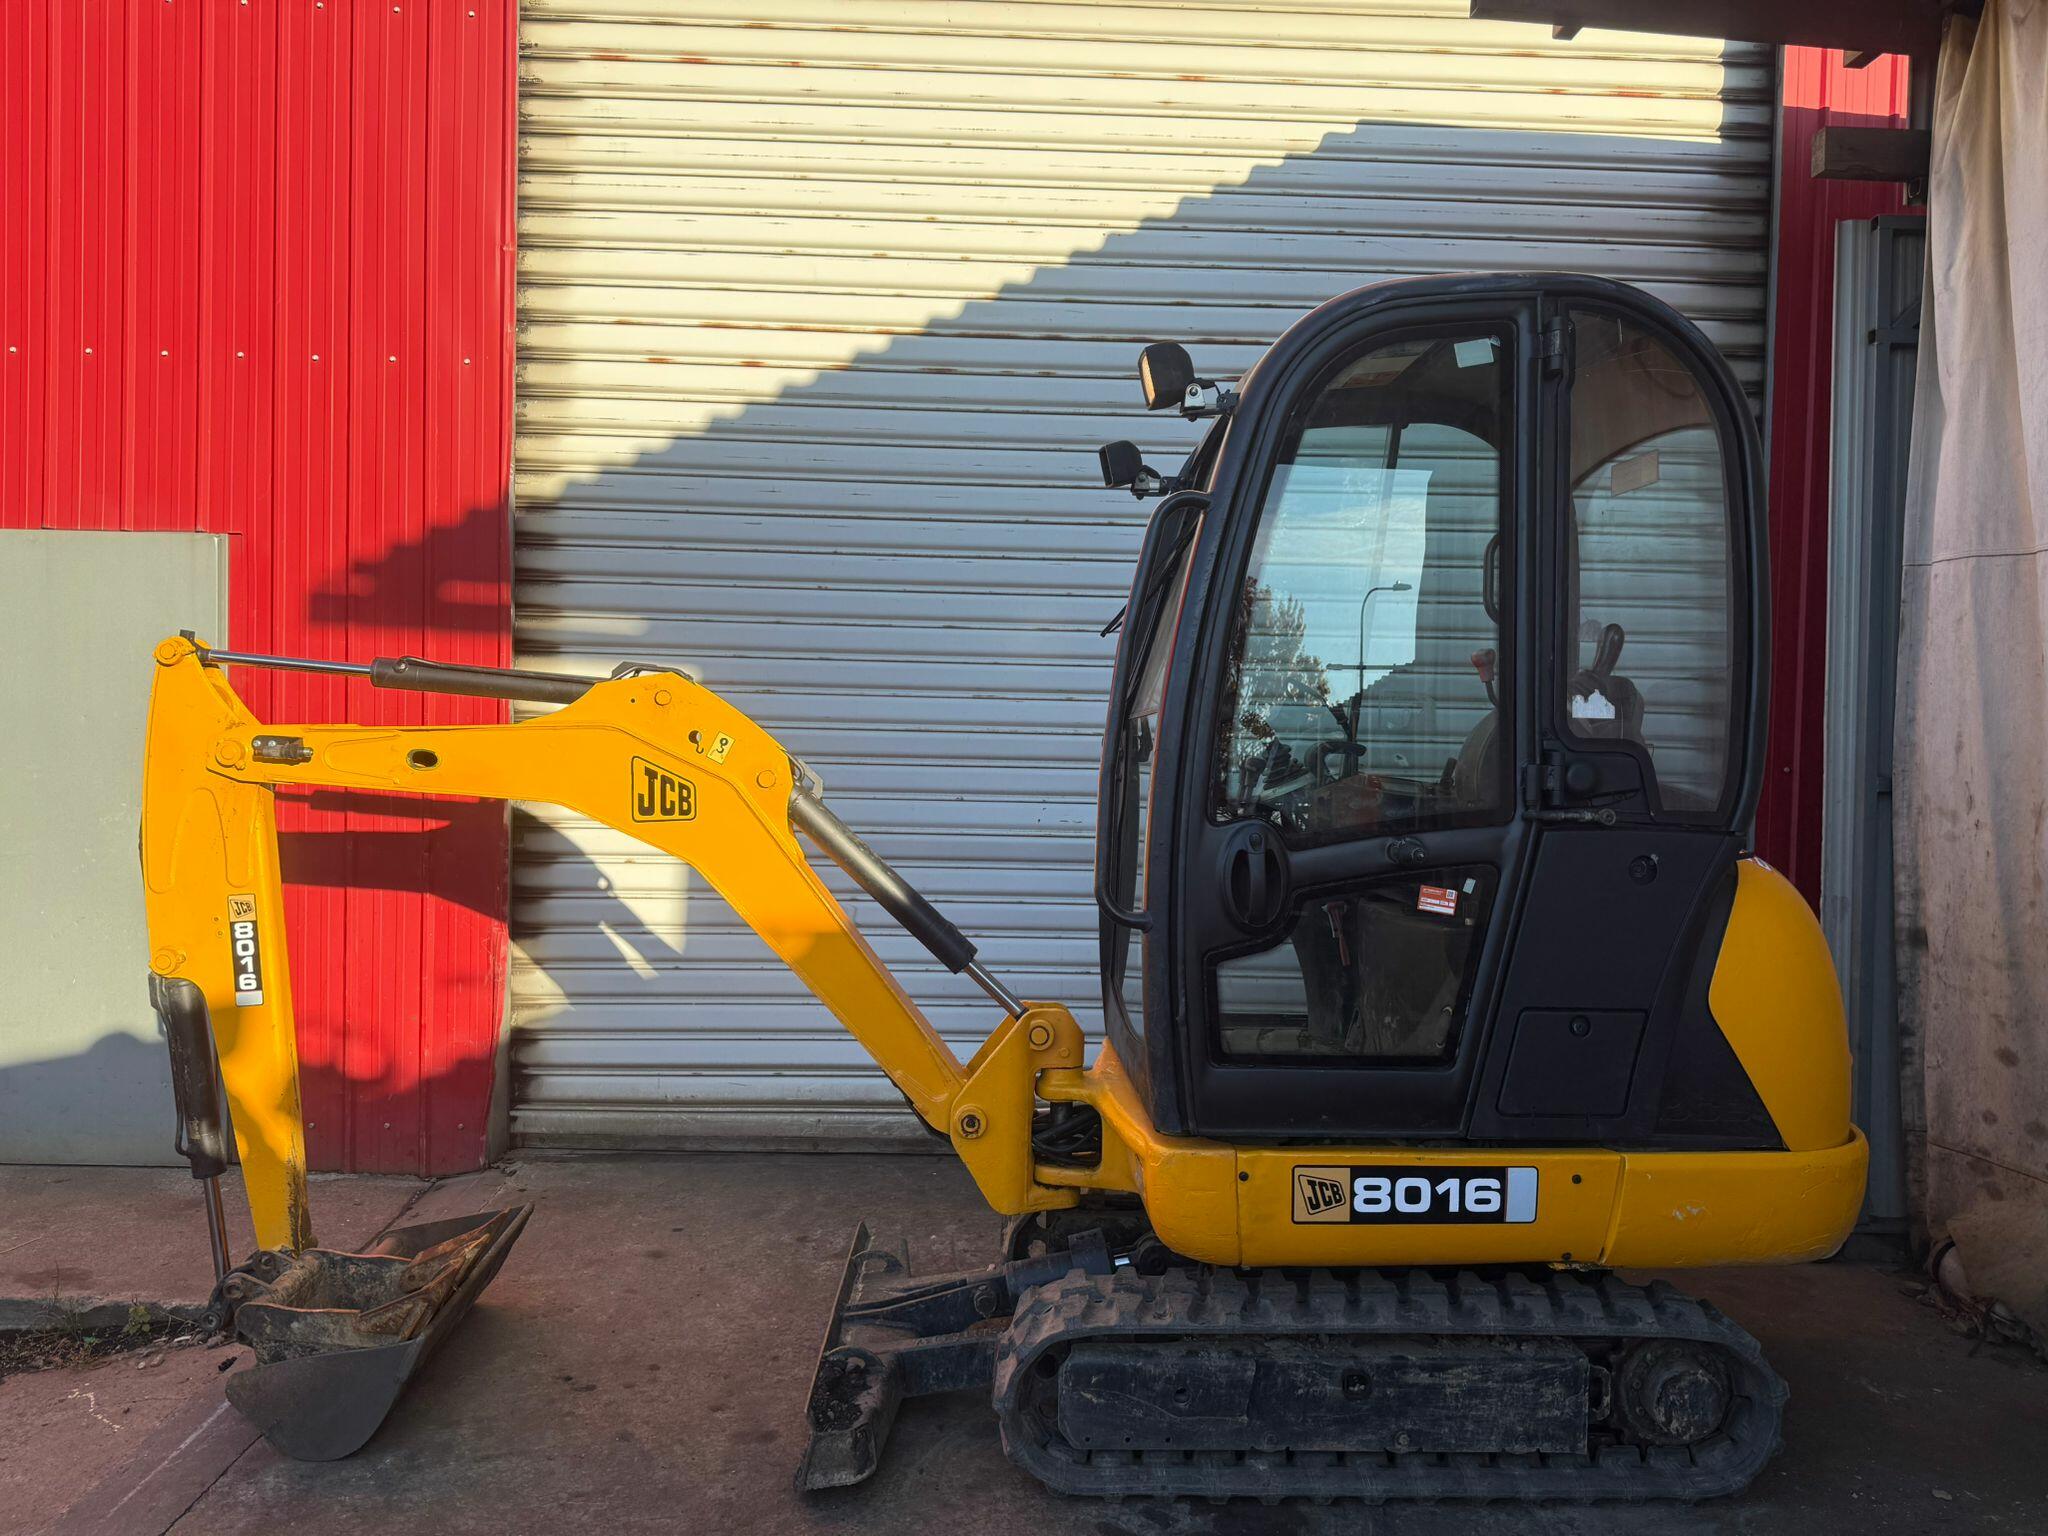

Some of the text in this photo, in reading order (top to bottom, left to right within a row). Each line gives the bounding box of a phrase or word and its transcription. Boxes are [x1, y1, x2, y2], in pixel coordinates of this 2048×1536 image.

[637, 766, 692, 816] JCB
[234, 901, 252, 916] JCB
[234, 921, 257, 990] 8016
[1306, 1177, 1501, 1213] JCB 8016
